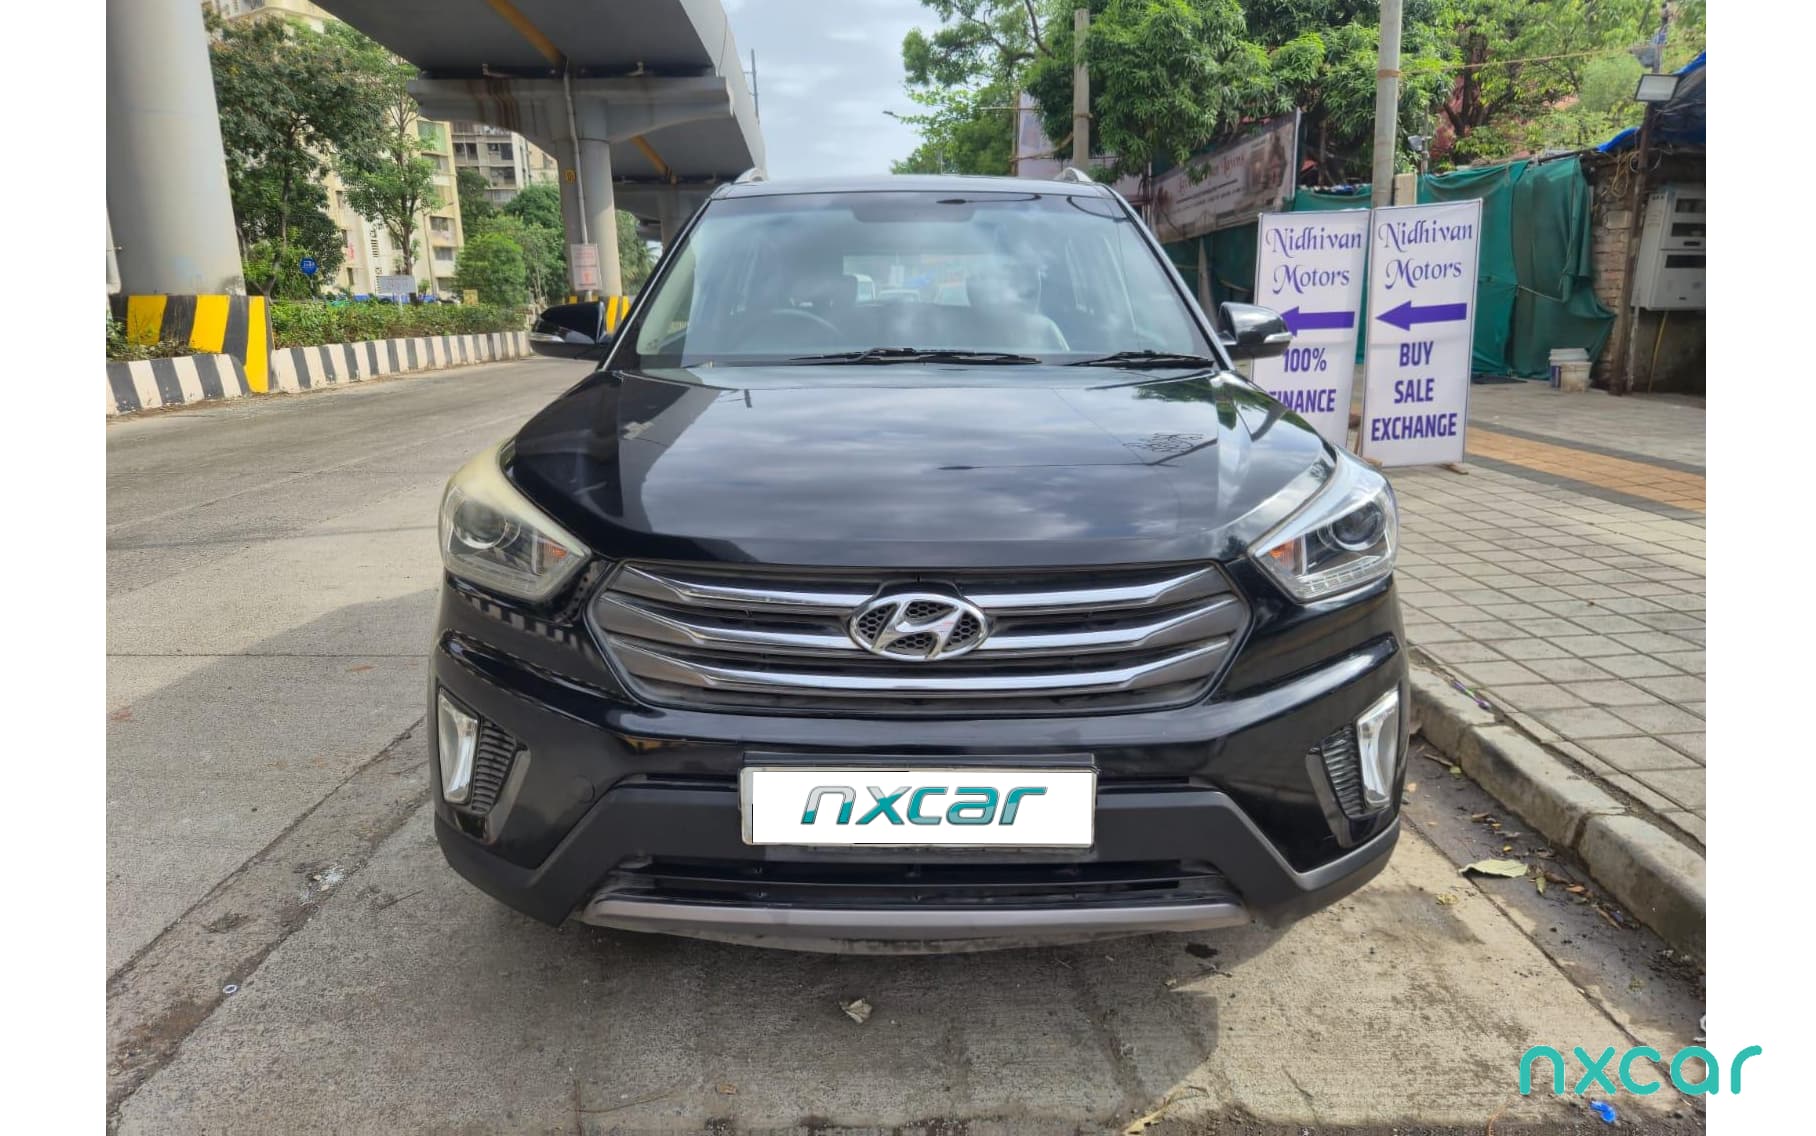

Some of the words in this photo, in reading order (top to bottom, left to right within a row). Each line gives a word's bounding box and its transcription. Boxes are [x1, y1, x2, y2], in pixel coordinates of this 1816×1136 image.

[1265, 226, 1362, 258] Nidhivan
[1377, 219, 1473, 252] Nidhivan
[1272, 264, 1350, 294] Motors
[1385, 258, 1462, 290] Motors
[1283, 347, 1327, 373] 100%
[1399, 340, 1434, 368] BUY
[1393, 378, 1435, 404] SALE
[1370, 412, 1458, 442] EXCHANGE
